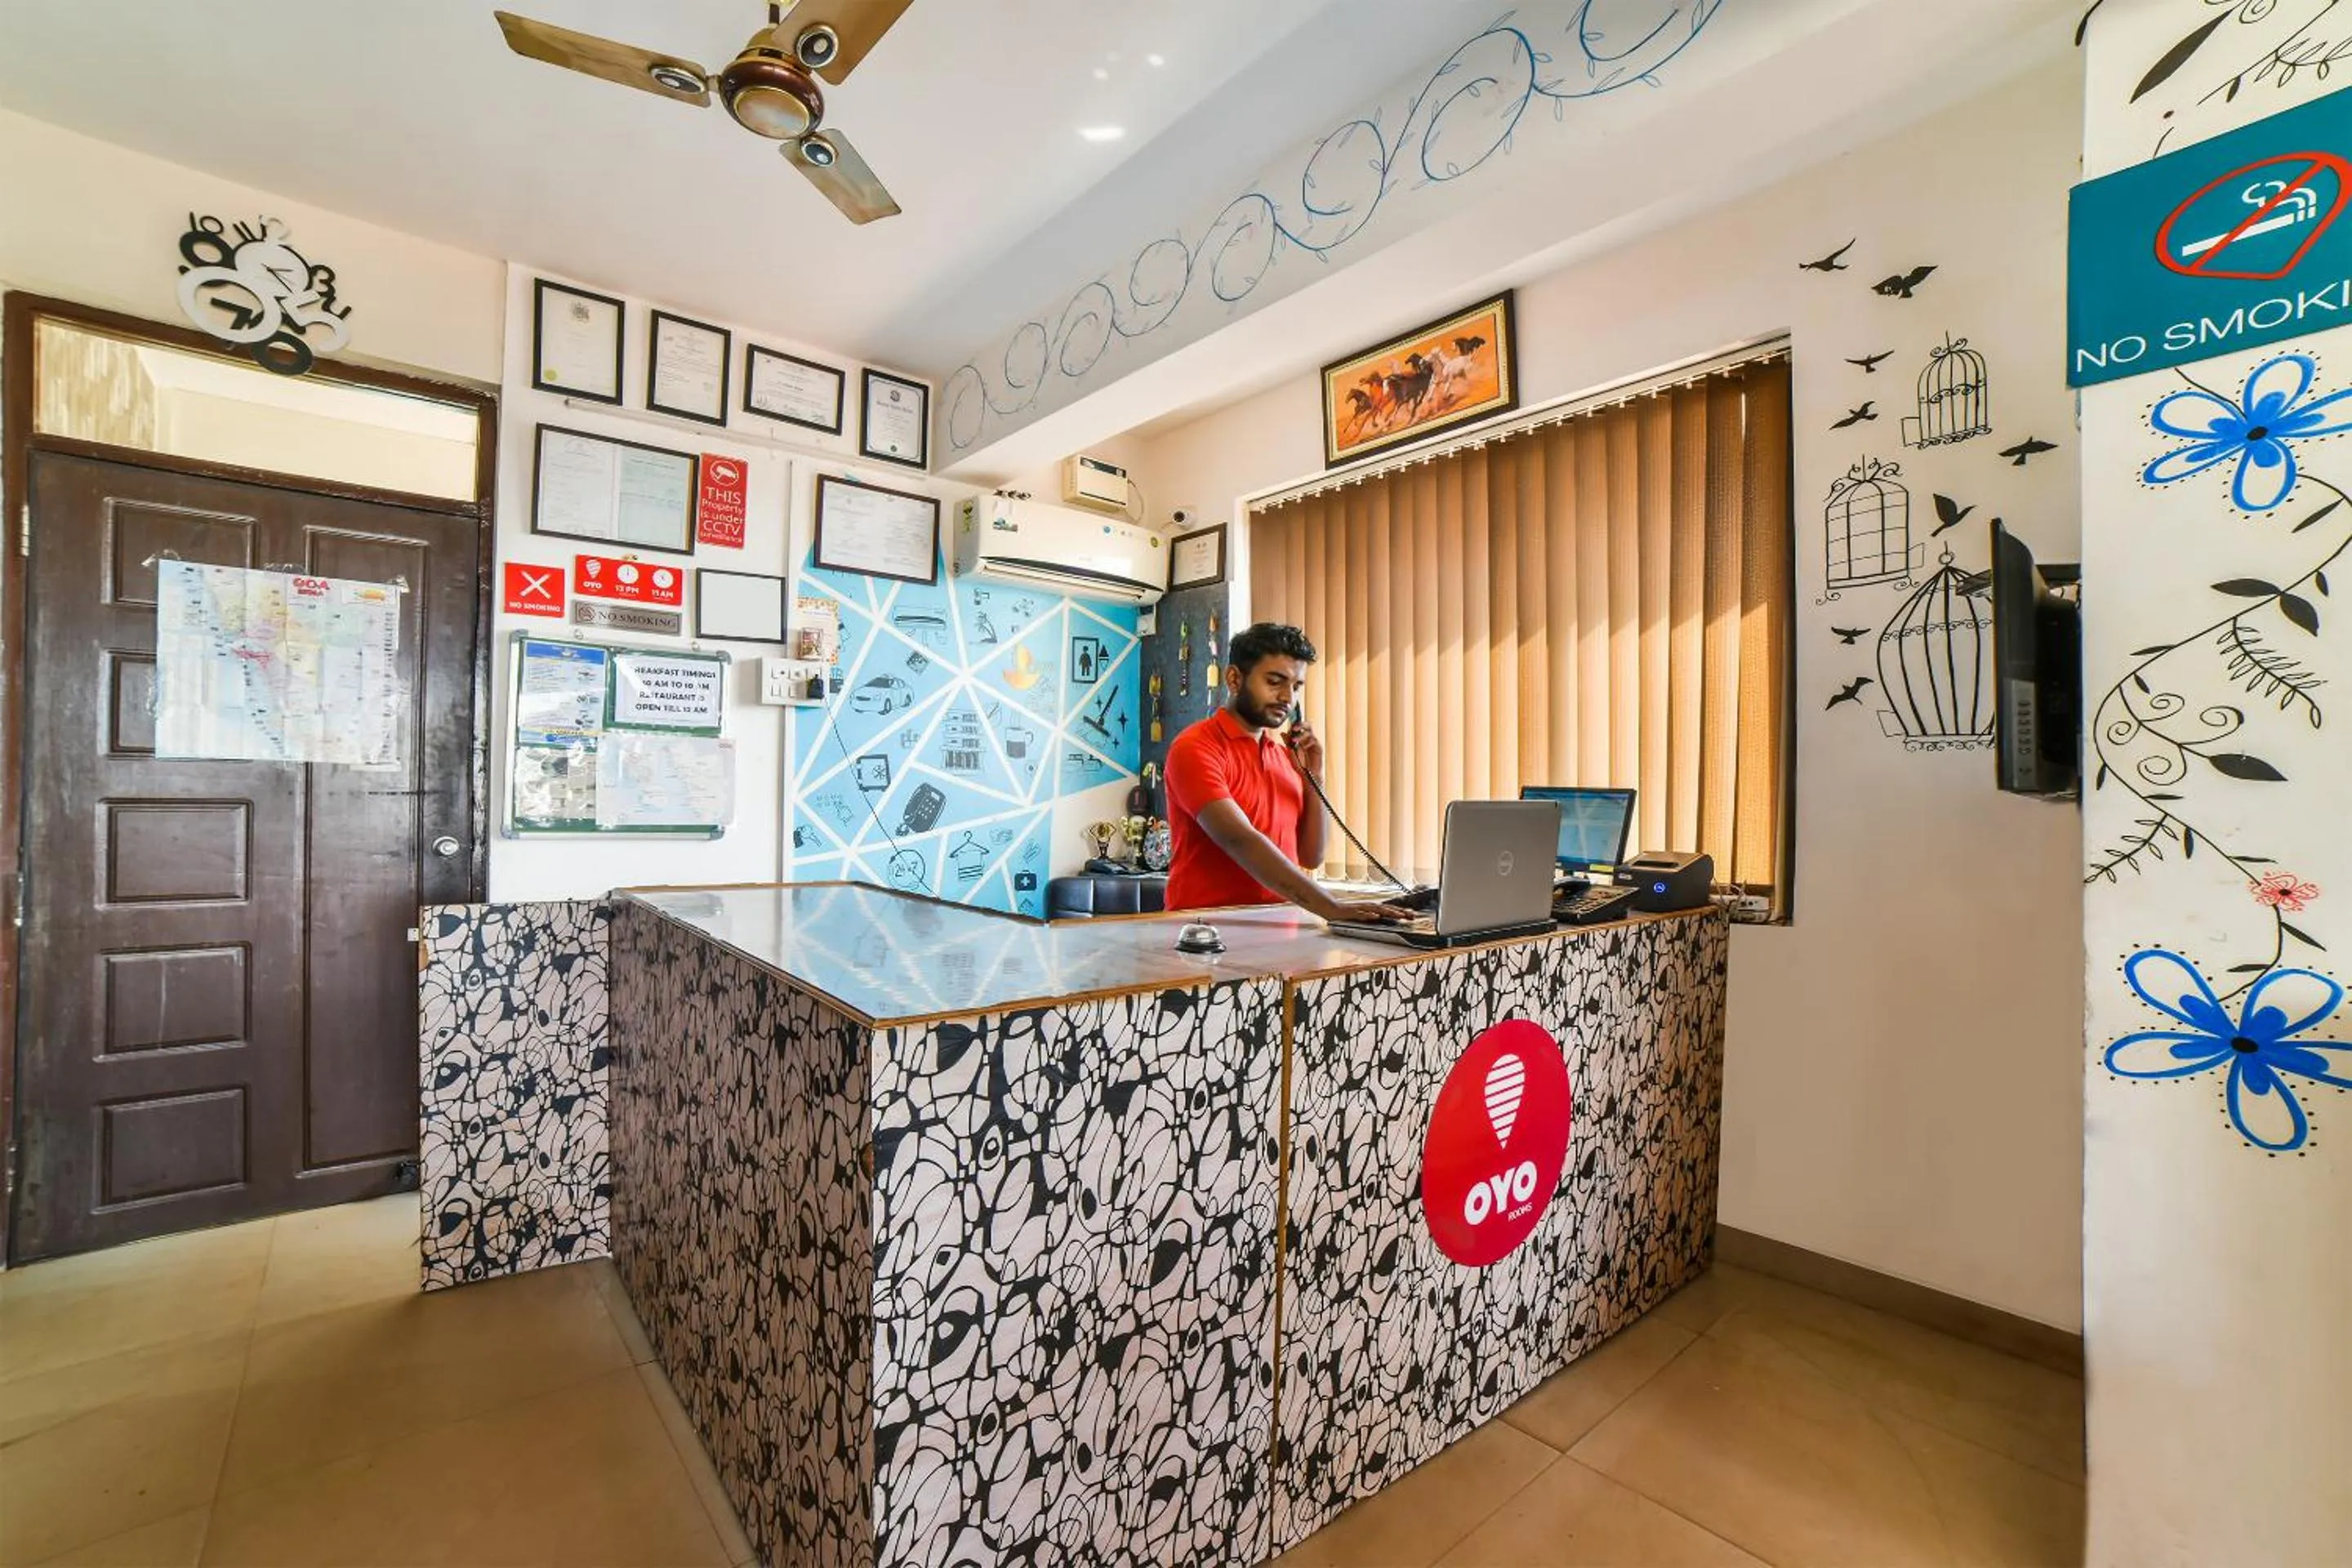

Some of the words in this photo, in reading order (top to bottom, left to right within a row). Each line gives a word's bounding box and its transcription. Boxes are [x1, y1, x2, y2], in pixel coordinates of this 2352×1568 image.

[2076, 336, 2147, 372] NO
[706, 486, 742, 505] THIS
[713, 512, 744, 524] under
[703, 519, 741, 537] CCTV
[582, 581, 603, 589] OYO
[660, 590, 673, 599] AM
[523, 603, 561, 612] SMOKING
[598, 611, 617, 621] NO
[619, 613, 676, 628] SMOKING
[631, 666, 679, 676] REAKFAST
[639, 691, 697, 701] RTAURANT
[635, 703, 661, 711] OPEN
[693, 706, 709, 714] AM
[1464, 1160, 1537, 1225] OYO
[1508, 1201, 1533, 1222] ROOMS
